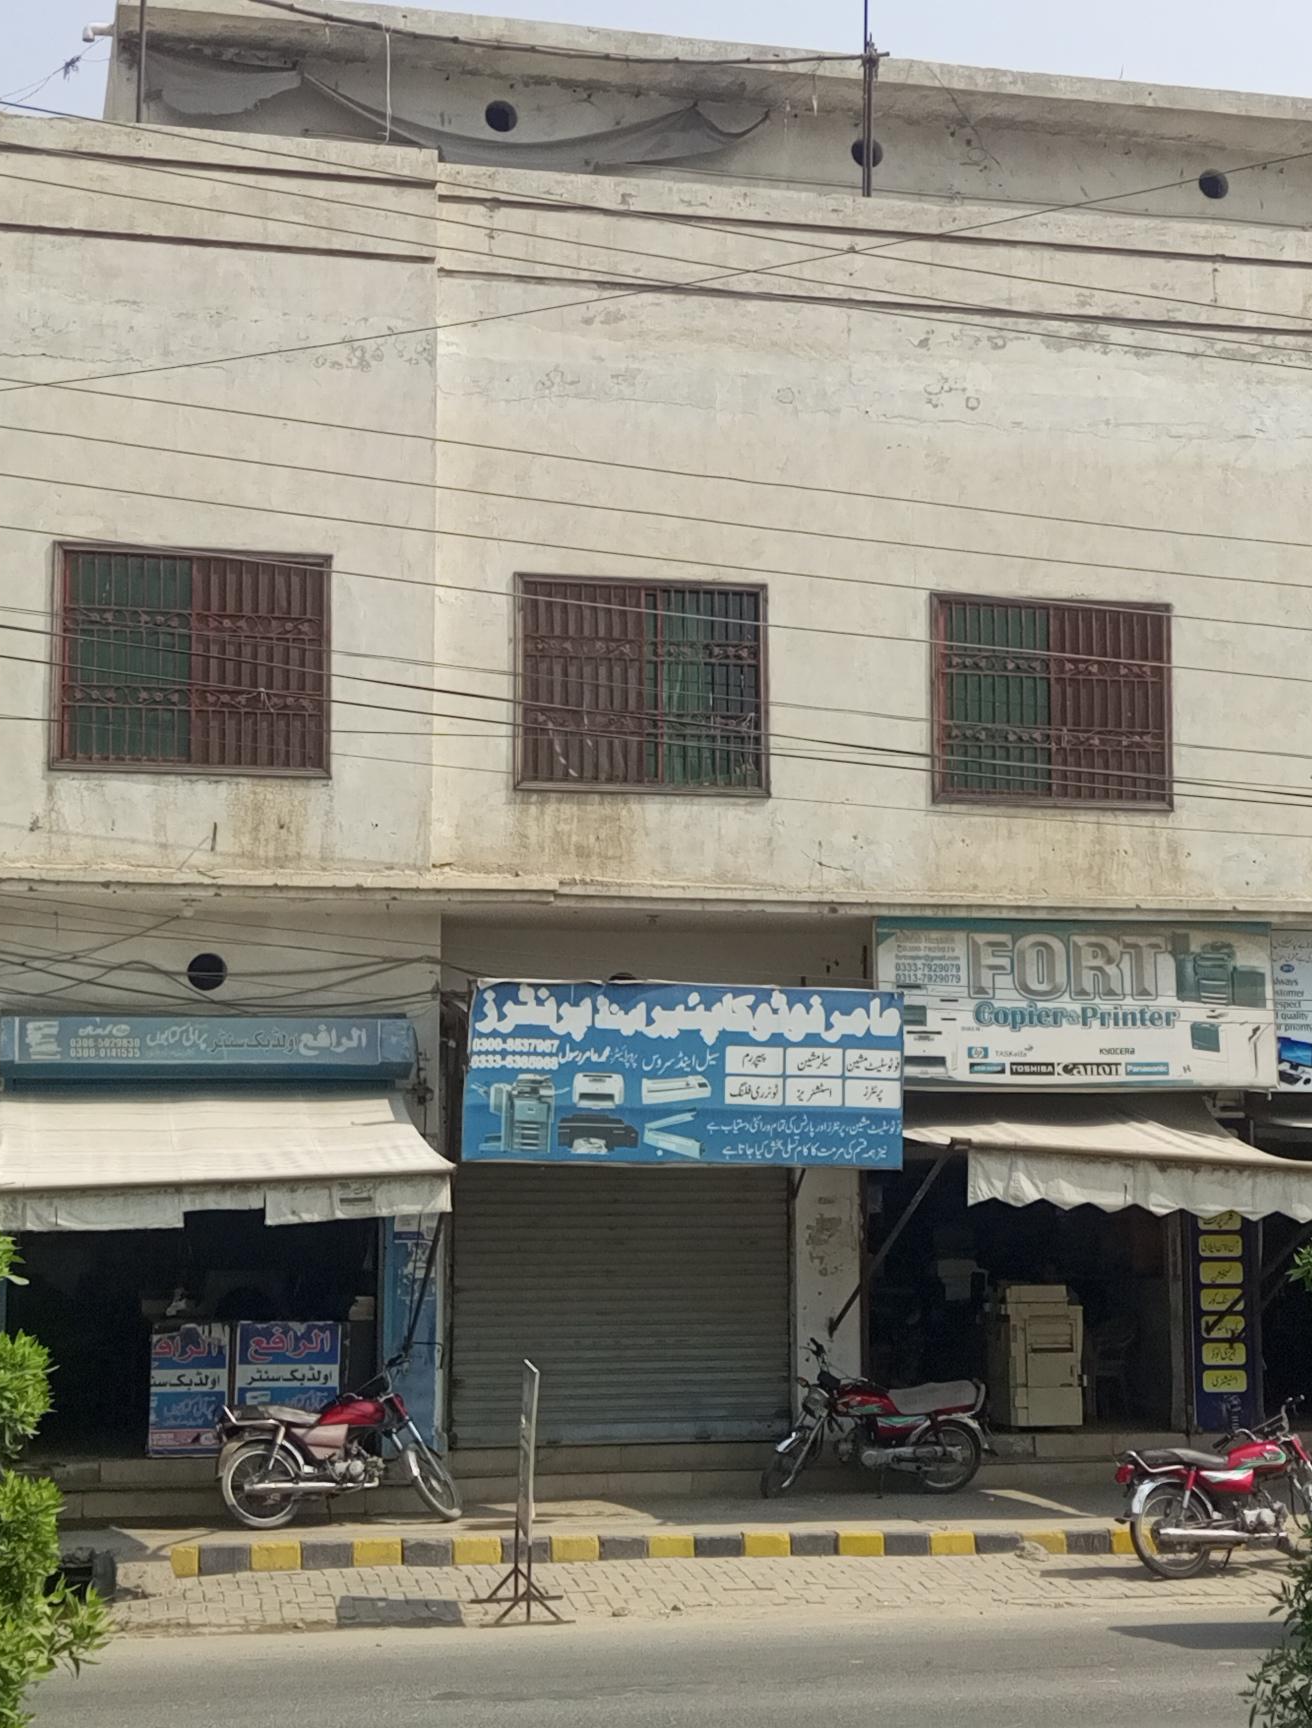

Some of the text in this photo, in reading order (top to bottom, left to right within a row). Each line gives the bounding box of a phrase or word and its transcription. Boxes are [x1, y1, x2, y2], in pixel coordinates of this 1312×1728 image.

[969, 932, 1167, 1001] FORT
[1274, 977, 1299, 987] lways
[1275, 989, 1305, 998] stomer
[975, 1001, 1068, 1033] Copier
[1080, 1003, 1180, 1030] Printer
[1275, 1001, 1302, 1010] espect
[299, 1024, 367, 1056] الرافع
[1011, 1064, 1055, 1073] TOSHIBA
[1057, 1062, 1122, 1076] Canon
[248, 1326, 331, 1364] الرافع
